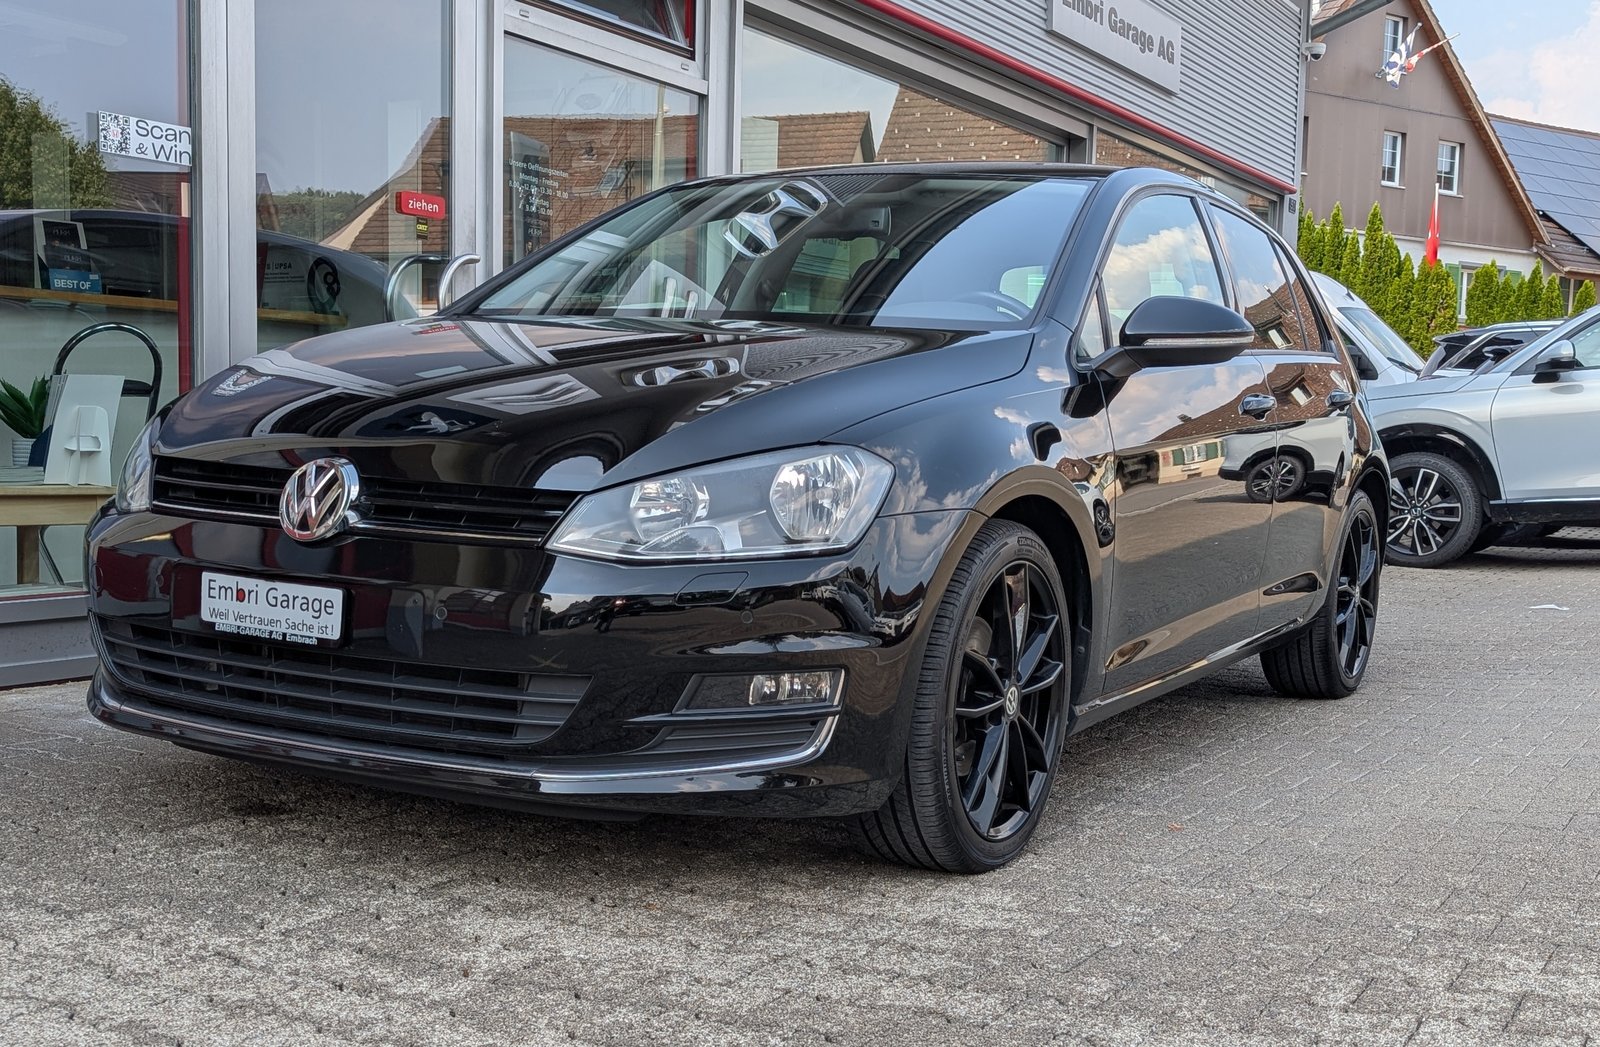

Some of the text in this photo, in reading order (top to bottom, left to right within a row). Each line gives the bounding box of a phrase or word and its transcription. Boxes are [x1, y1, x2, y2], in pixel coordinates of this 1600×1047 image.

[1062, 0, 1175, 64] mbri Garage AG
[135, 119, 191, 145] Scan
[135, 142, 192, 165] & Win
[519, 172, 539, 185] Montag
[542, 177, 559, 189] Freitag
[408, 198, 439, 213] ziehen
[54, 279, 91, 290] BEST OF
[207, 579, 335, 619] Embri Garage
[208, 606, 230, 621] Weil
[232, 611, 282, 629] Vertrauen
[285, 617, 315, 633] Sache
[285, 633, 318, 645] Embrach
